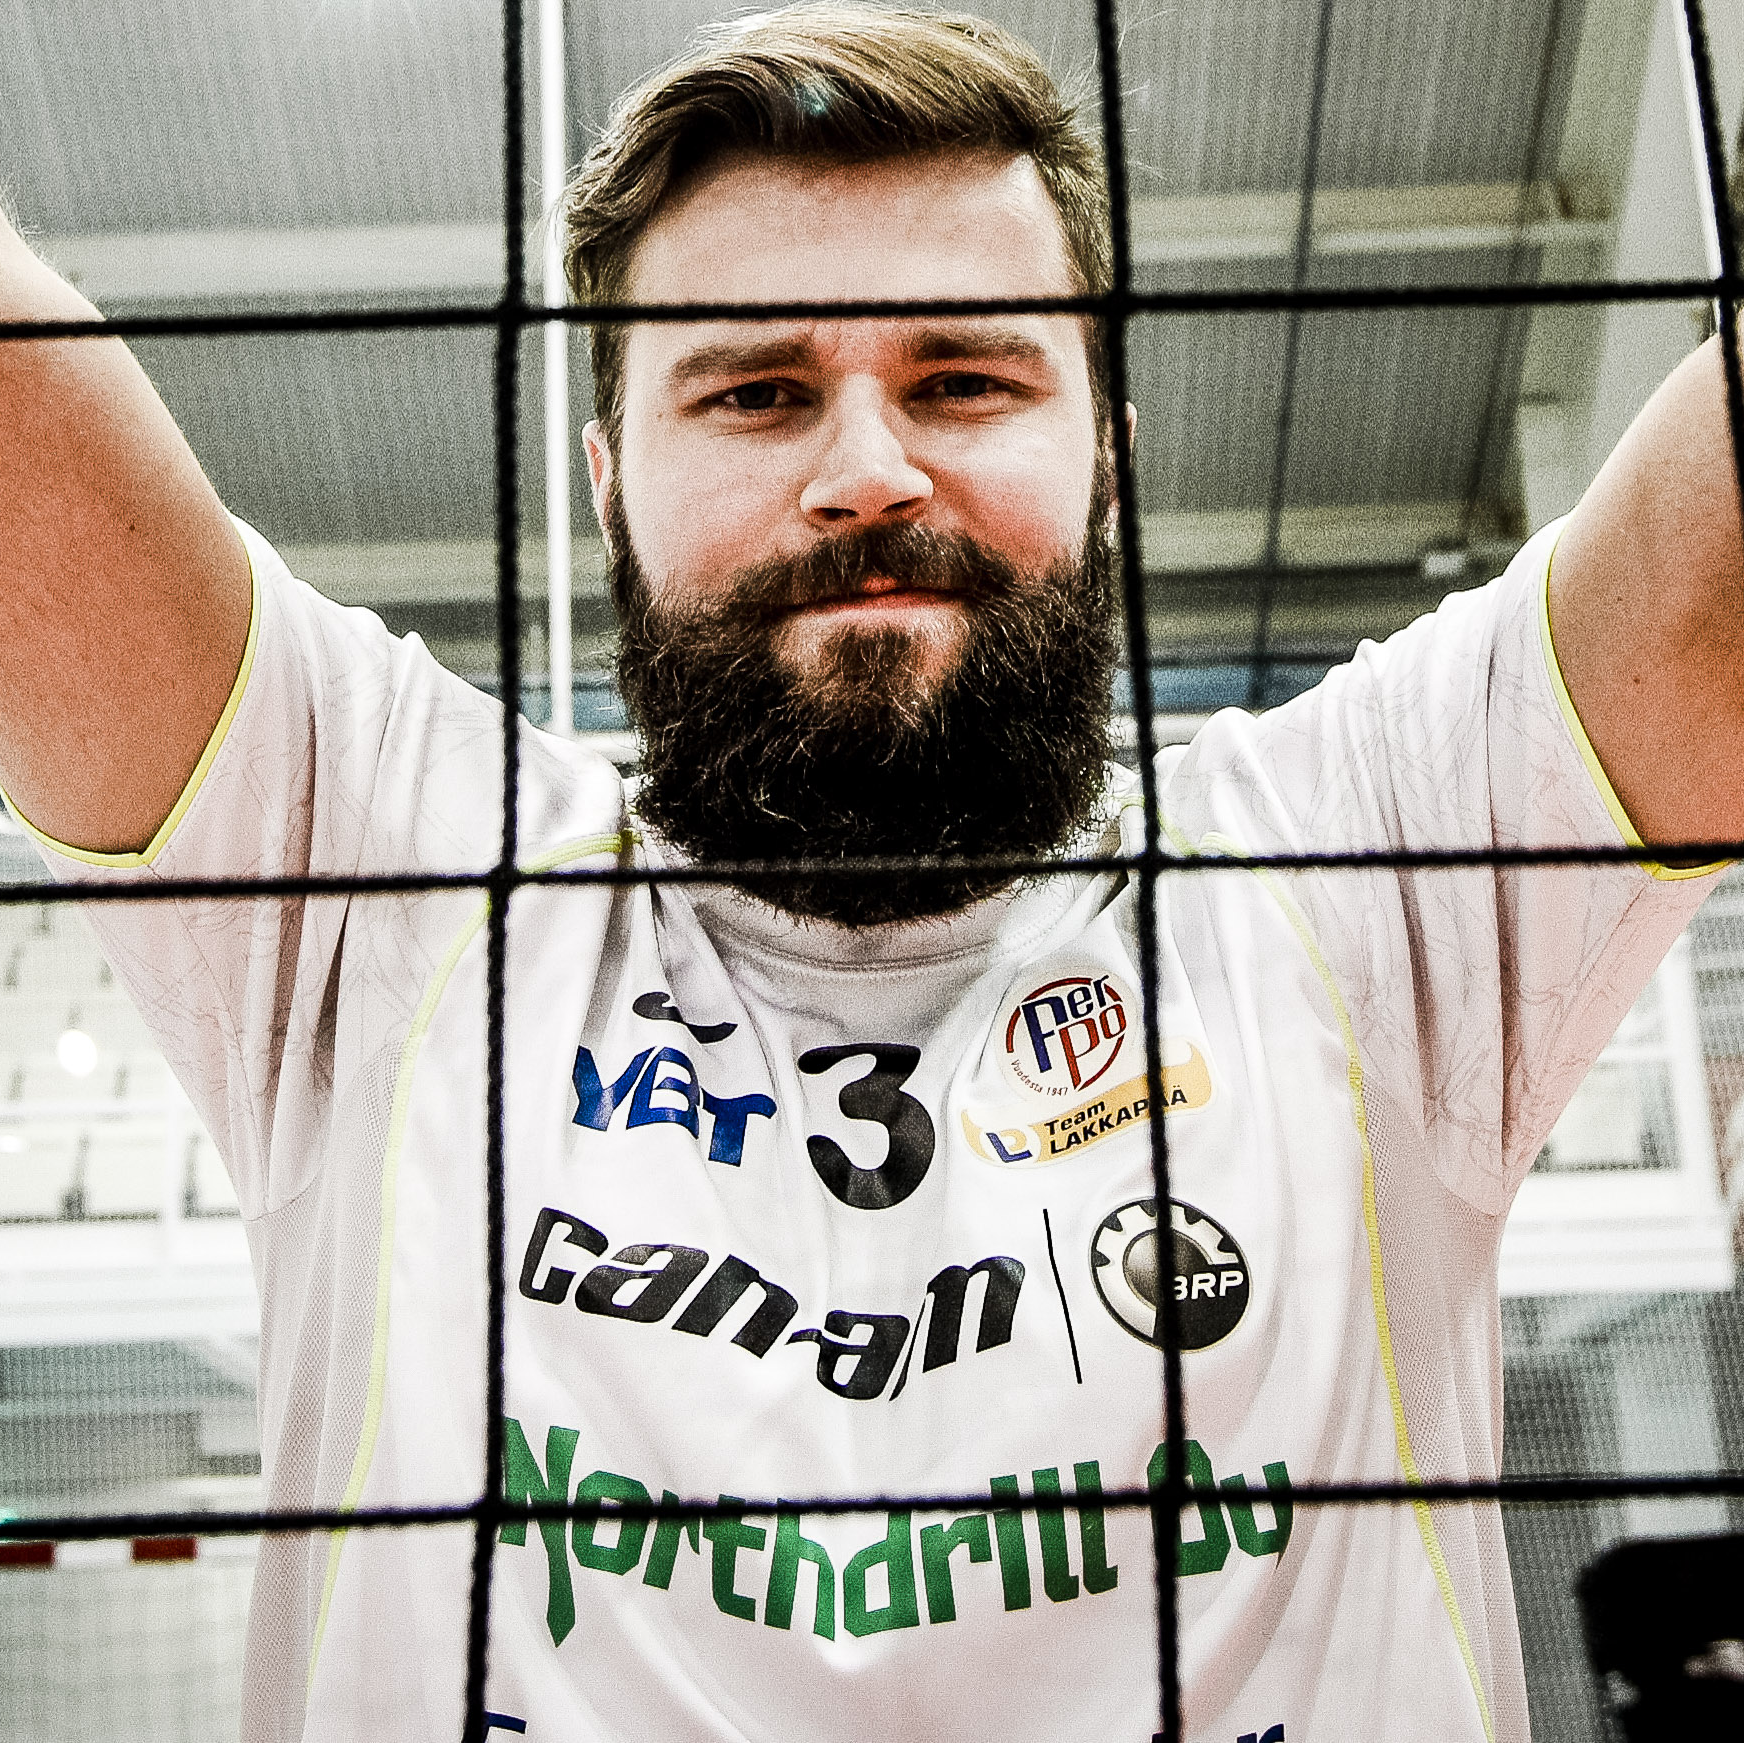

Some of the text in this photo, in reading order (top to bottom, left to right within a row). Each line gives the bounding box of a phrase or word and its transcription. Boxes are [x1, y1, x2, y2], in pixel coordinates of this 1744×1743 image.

[797, 1042, 936, 1210] 3
[1011, 1059, 1069, 1097] Vuodesta 1947
[1044, 1101, 1106, 1135] Team
[499, 1416, 1120, 1648] Northdrill
